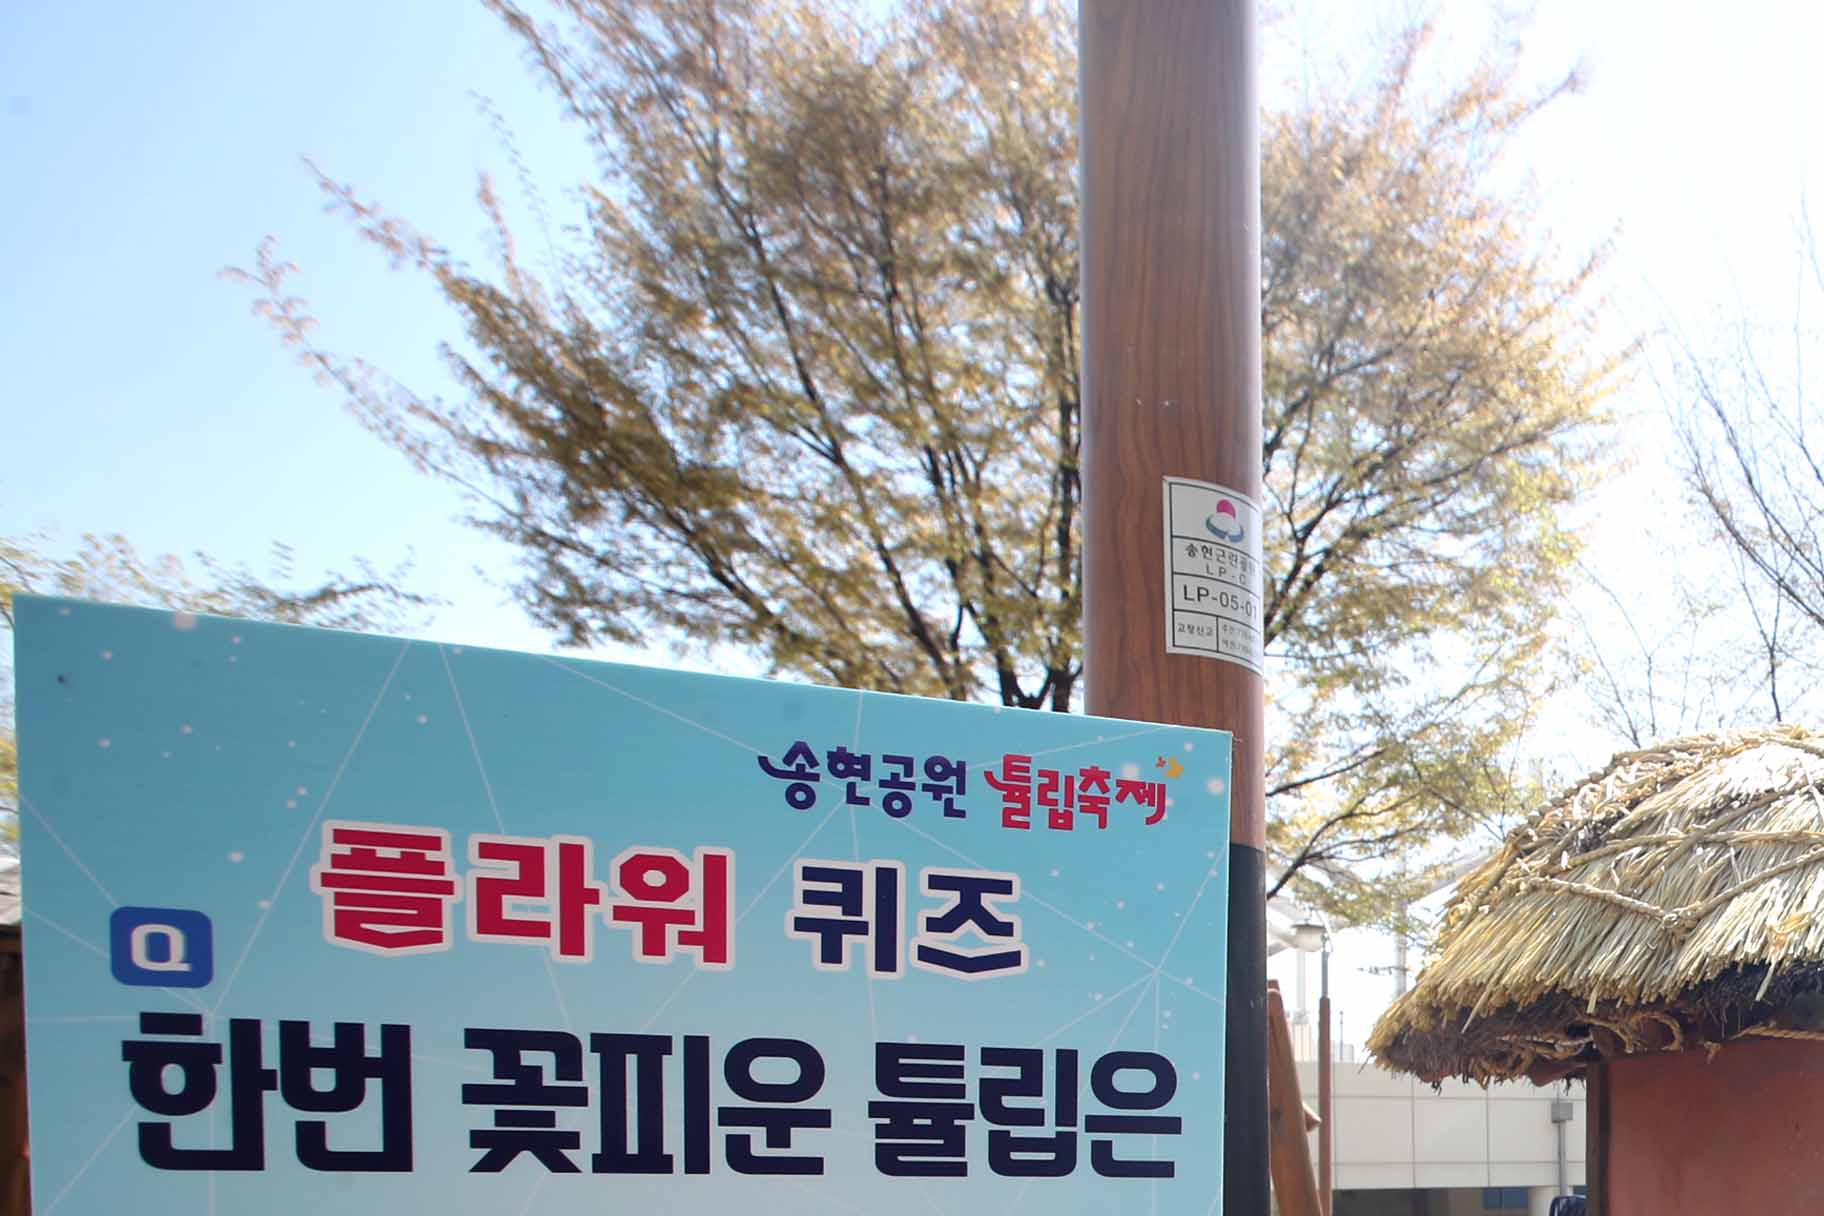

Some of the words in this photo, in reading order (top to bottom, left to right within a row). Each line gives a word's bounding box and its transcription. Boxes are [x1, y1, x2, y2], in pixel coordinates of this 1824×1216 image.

[757, 741, 967, 819] 송현공원
[984, 753, 1167, 831] 튤립축제
[131, 923, 192, 972] Q
[320, 827, 729, 965] 플라워
[792, 865, 1023, 975] 퀴즈
[121, 1011, 415, 1173] 한번
[461, 1027, 832, 1176] 꽃피운
[867, 1041, 1182, 1178] 튤립은
